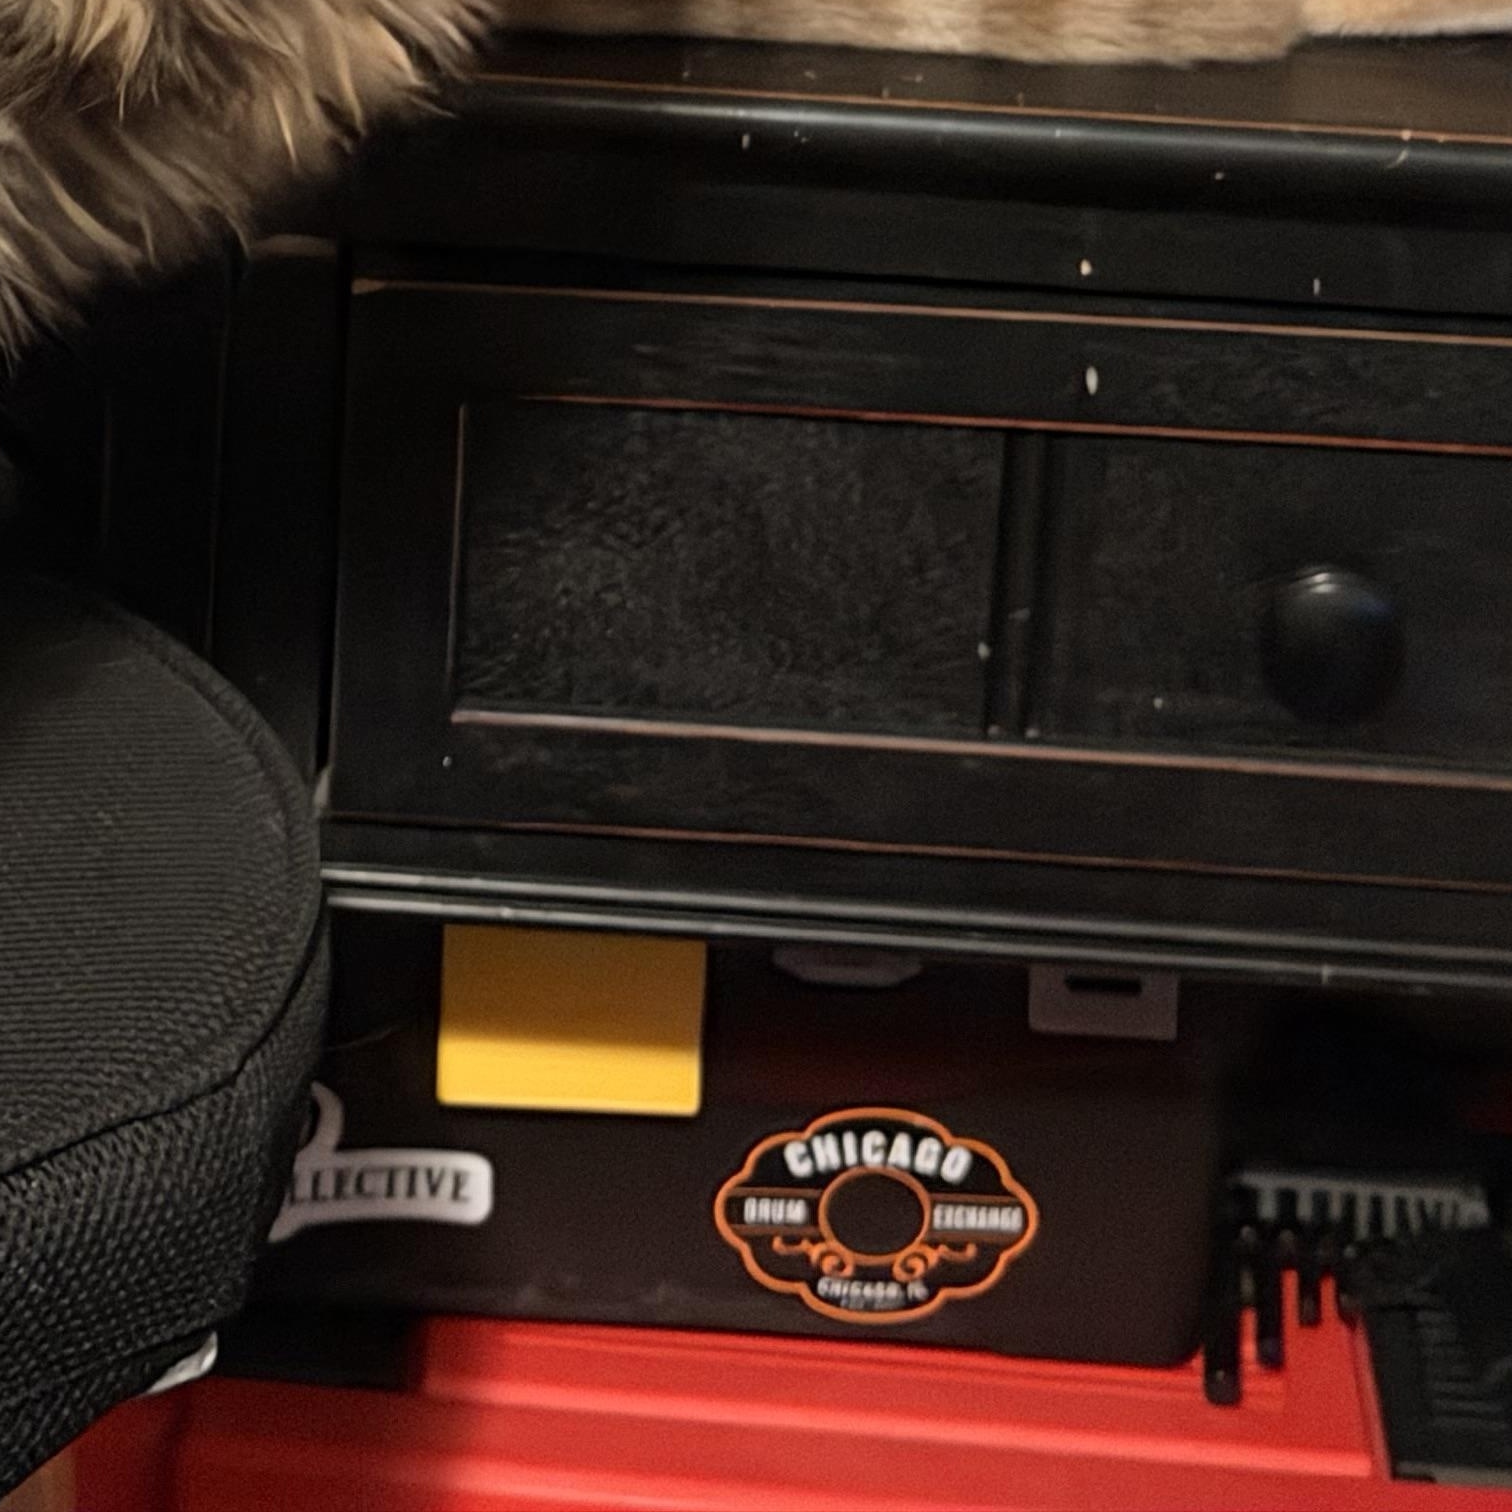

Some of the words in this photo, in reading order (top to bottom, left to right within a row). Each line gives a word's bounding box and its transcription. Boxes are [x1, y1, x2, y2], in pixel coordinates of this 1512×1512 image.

[783, 1129, 973, 1185] CHICAGO
[744, 1196, 808, 1225] DRUM
[933, 1203, 1024, 1232] EXCHANGE
